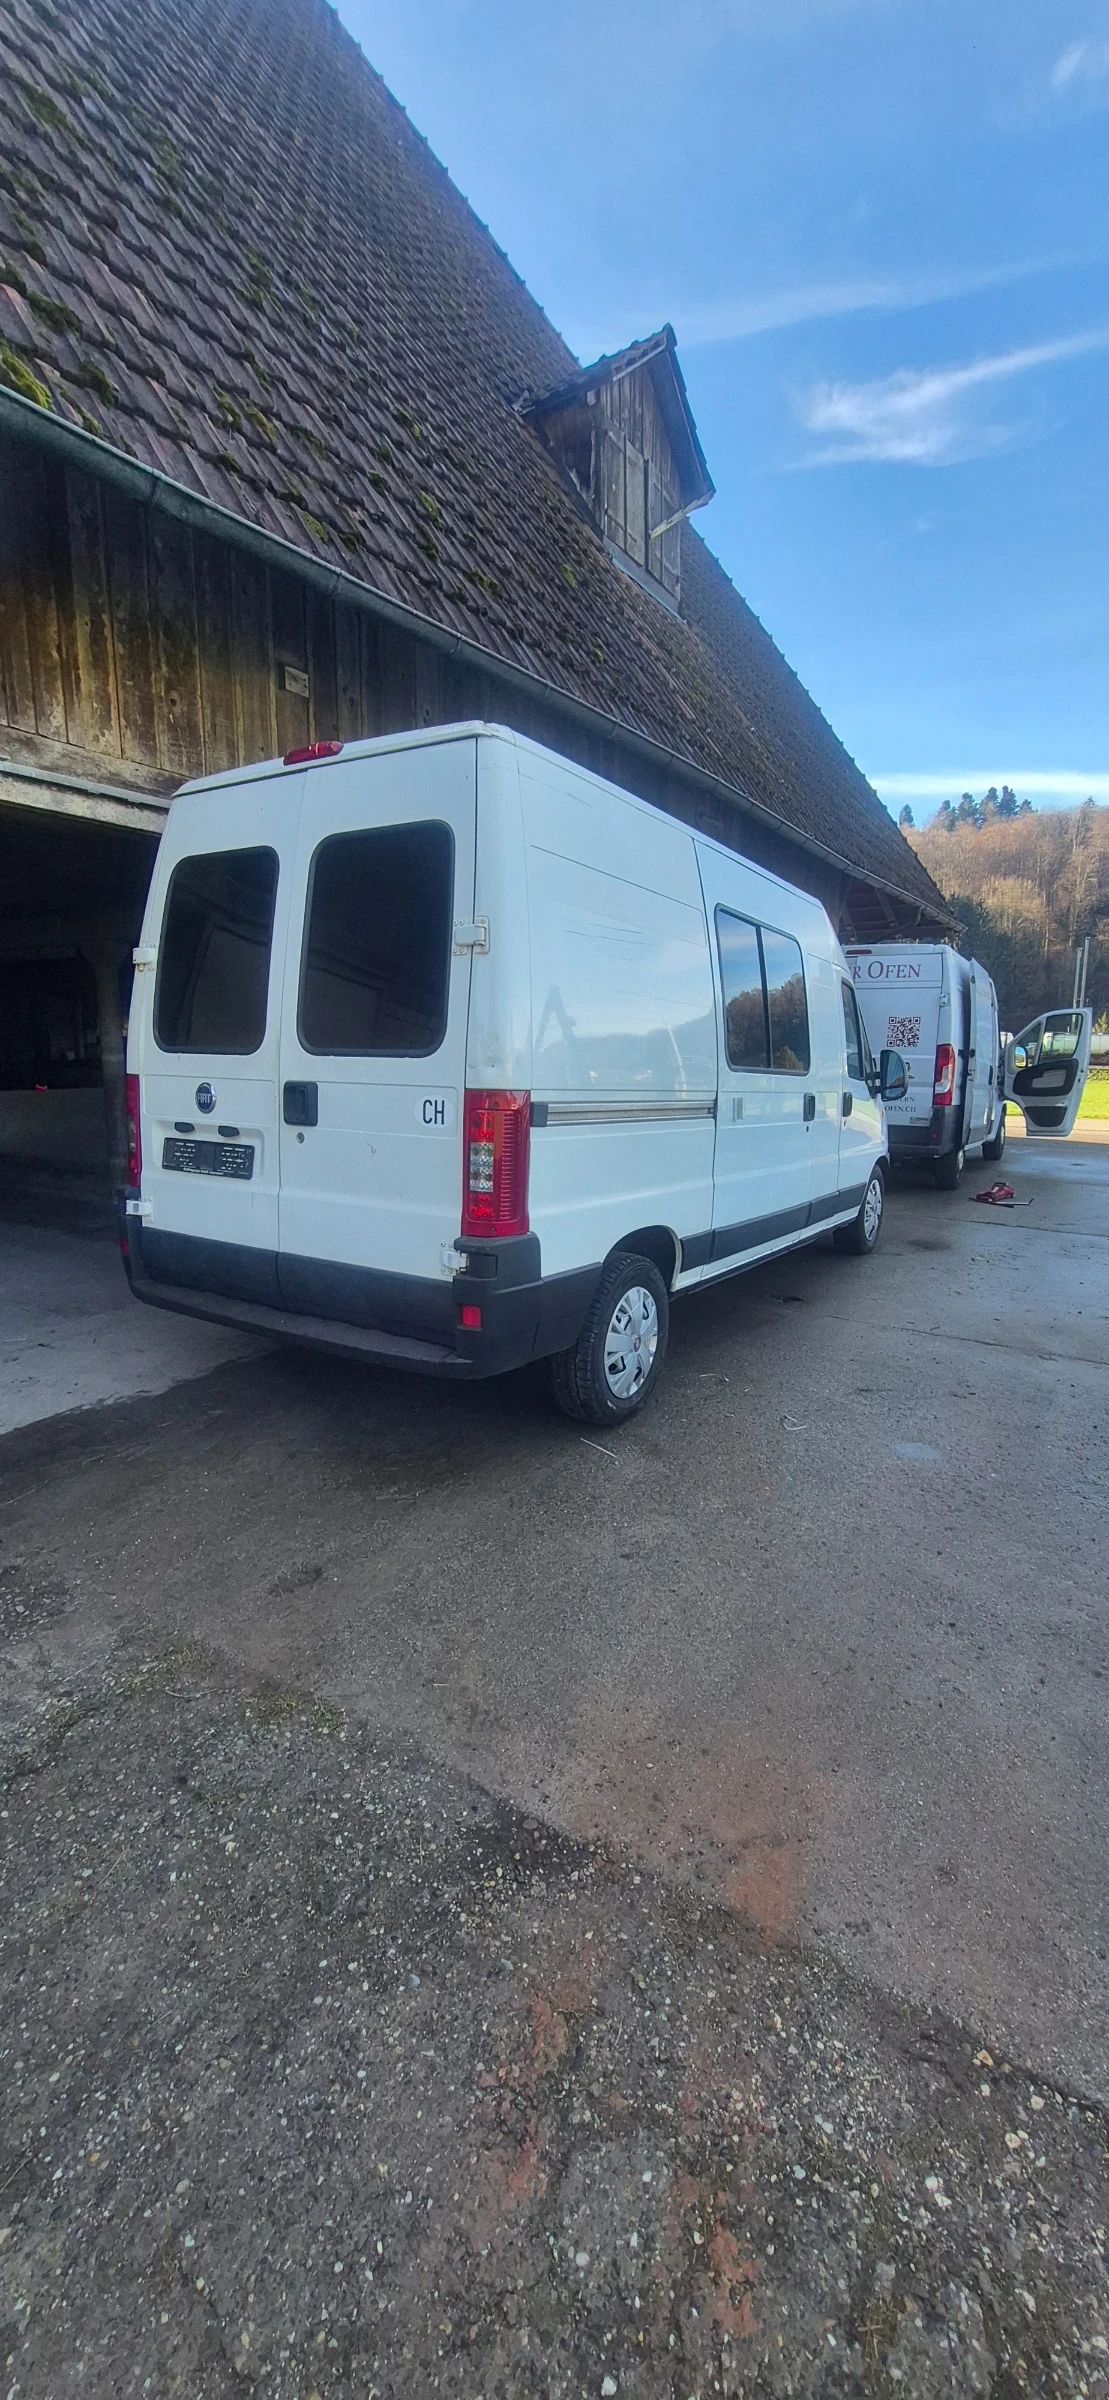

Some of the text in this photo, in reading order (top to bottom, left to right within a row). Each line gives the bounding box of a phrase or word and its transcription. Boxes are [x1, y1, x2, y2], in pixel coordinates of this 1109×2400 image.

[867, 960, 922, 979] OFEN
[197, 1093, 212, 1104] FIAT
[422, 1099, 445, 1125] CH
